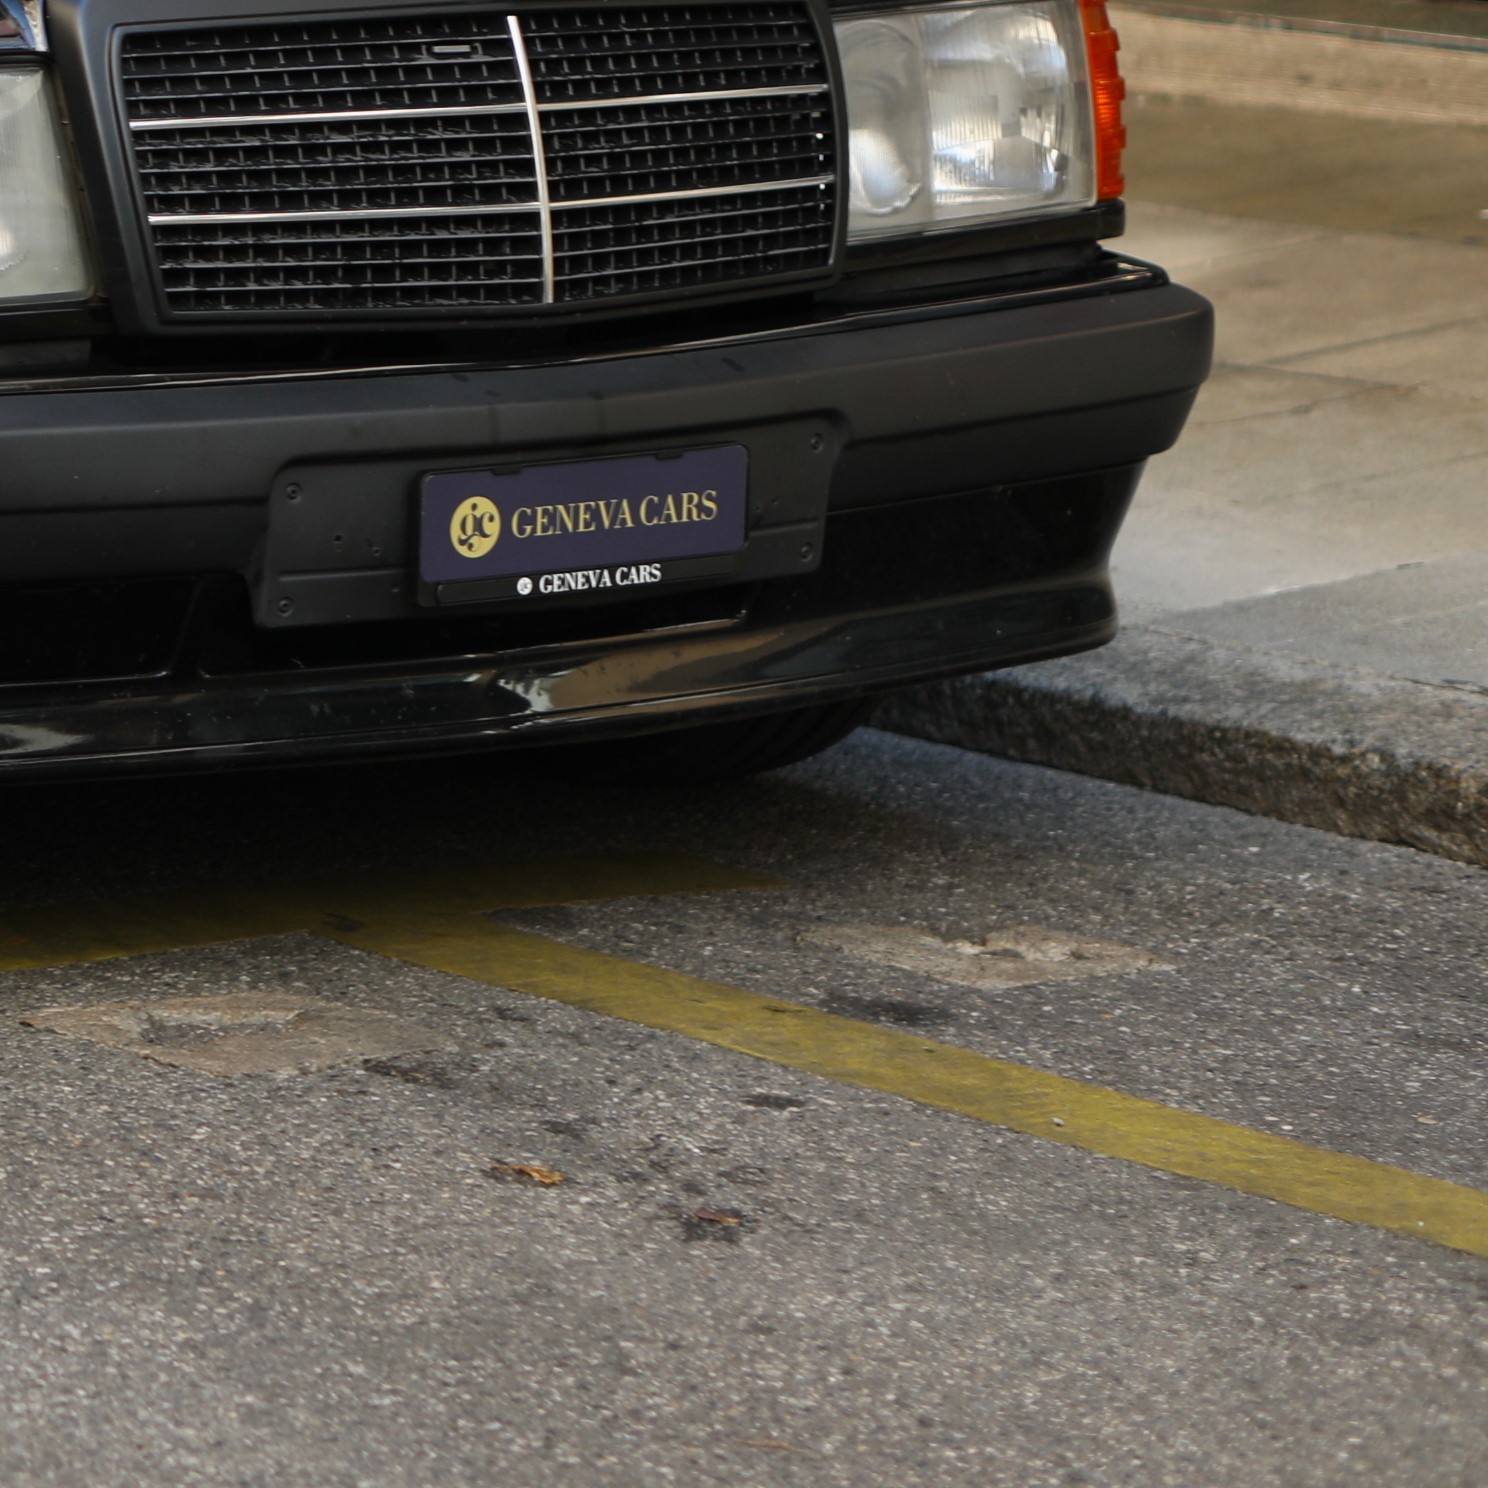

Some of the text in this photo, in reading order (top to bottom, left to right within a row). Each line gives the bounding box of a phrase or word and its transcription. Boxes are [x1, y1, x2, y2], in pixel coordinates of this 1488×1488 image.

[511, 498, 635, 539] GENEVA
[639, 490, 718, 527] CARS
[539, 569, 612, 594] GENEVA
[615, 563, 662, 586] CARS
